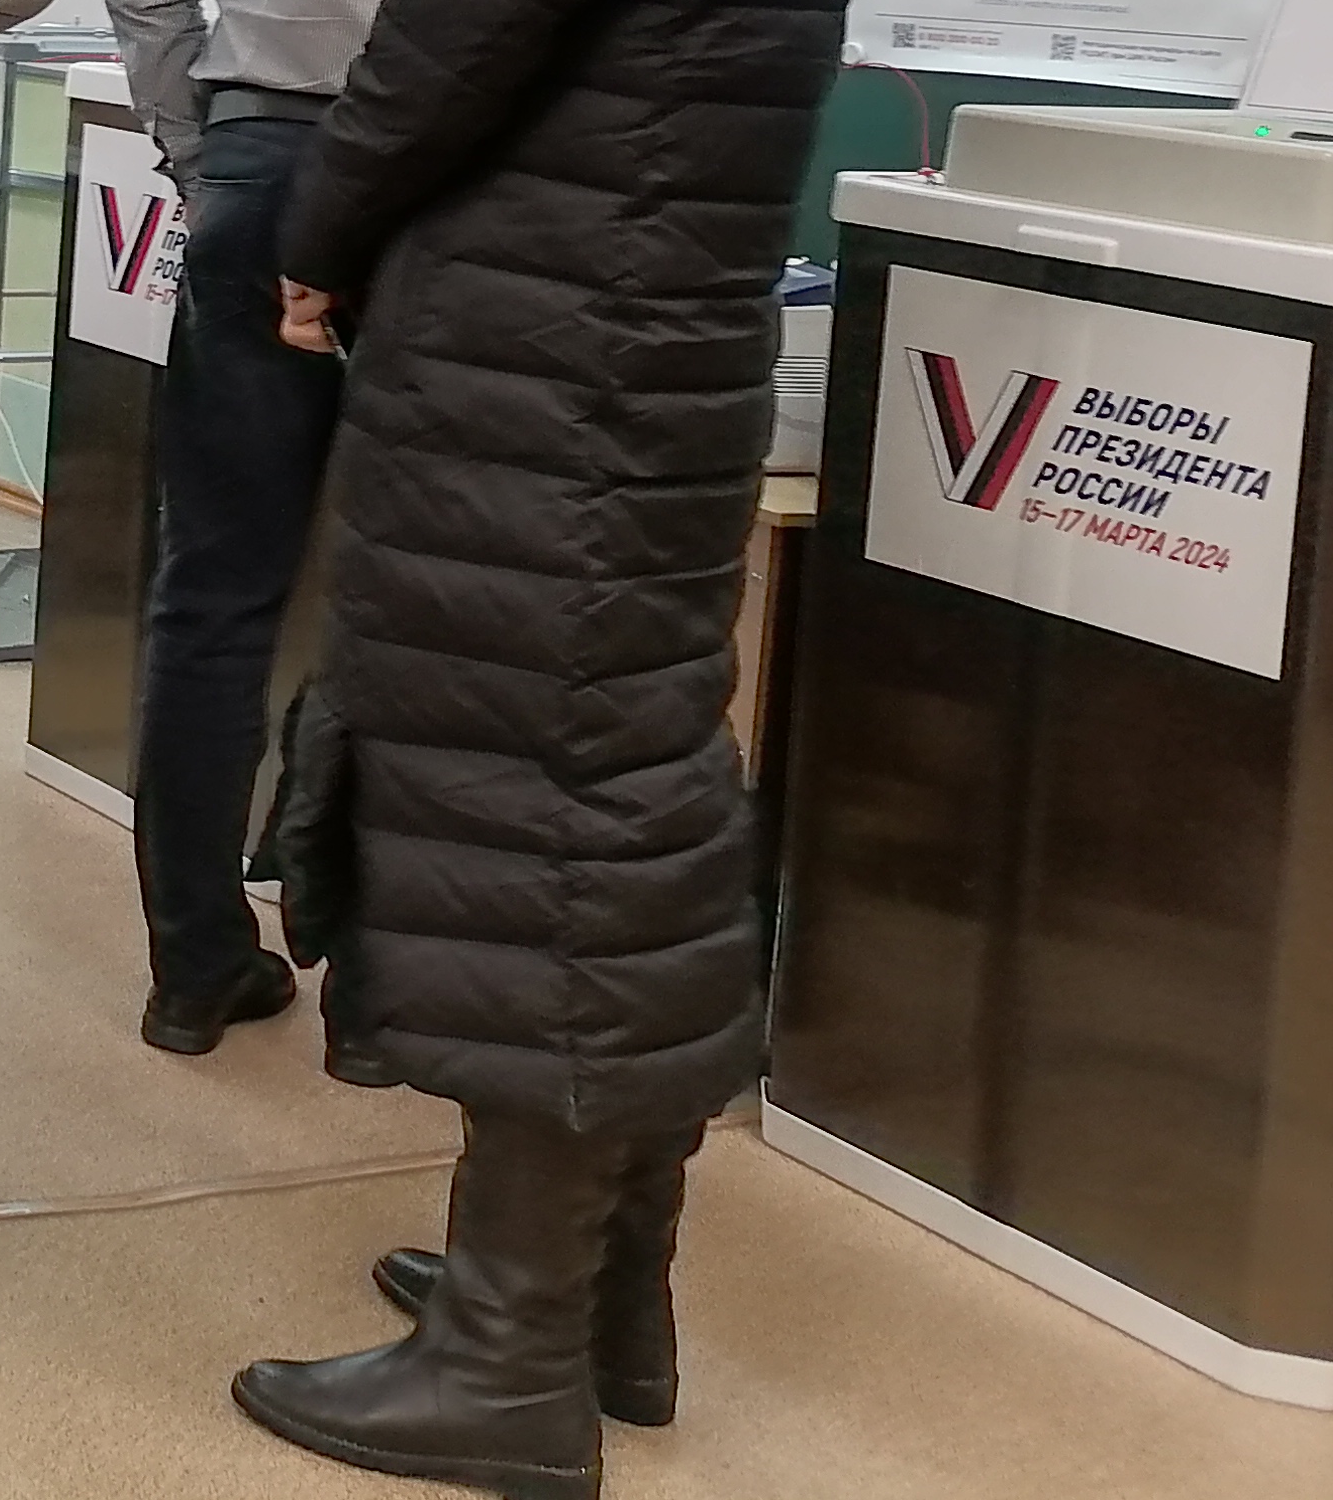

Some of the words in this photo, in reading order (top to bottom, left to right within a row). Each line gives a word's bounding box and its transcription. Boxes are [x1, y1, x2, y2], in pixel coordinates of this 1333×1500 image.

[151, 257, 185, 281] РОС
[1073, 387, 1231, 446] ВЫБОРЫ
[1032, 461, 1172, 518] РОССИИ
[1051, 424, 1272, 500] ПРЕЗИДЕНТА
[1083, 512, 1167, 559] МАРТА
[1168, 536, 1231, 573] 2024
